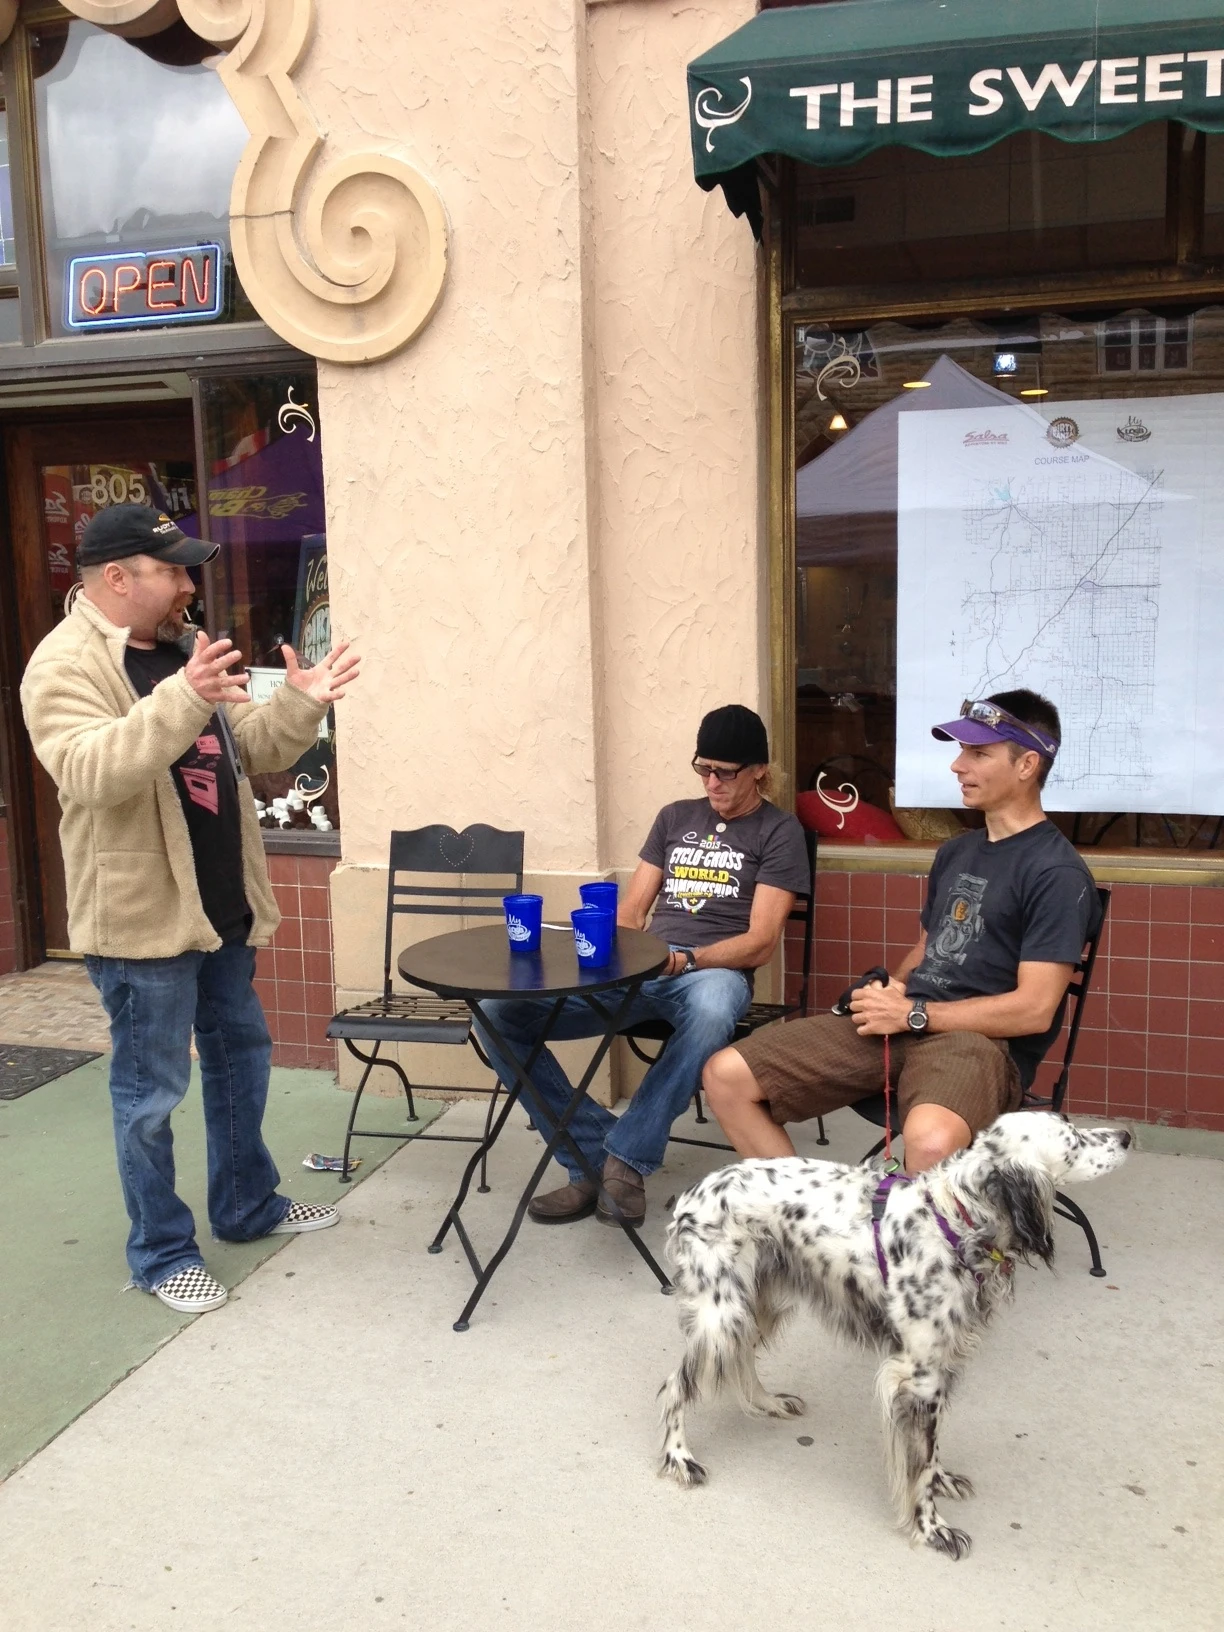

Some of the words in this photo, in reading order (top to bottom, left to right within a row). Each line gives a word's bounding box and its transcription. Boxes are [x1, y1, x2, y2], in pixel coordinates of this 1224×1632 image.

[789, 75, 933, 130] THE
[967, 49, 1224, 117] SWEET
[81, 257, 210, 315] OPEN
[963, 430, 1009, 443] Salsa
[1034, 456, 1070, 465] COURSE
[1071, 455, 1089, 463] MAP
[91, 473, 145, 504] 805
[699, 839, 721, 849] 2013
[669, 847, 744, 871] CYCLO-CROSS
[674, 866, 729, 883] WORLD
